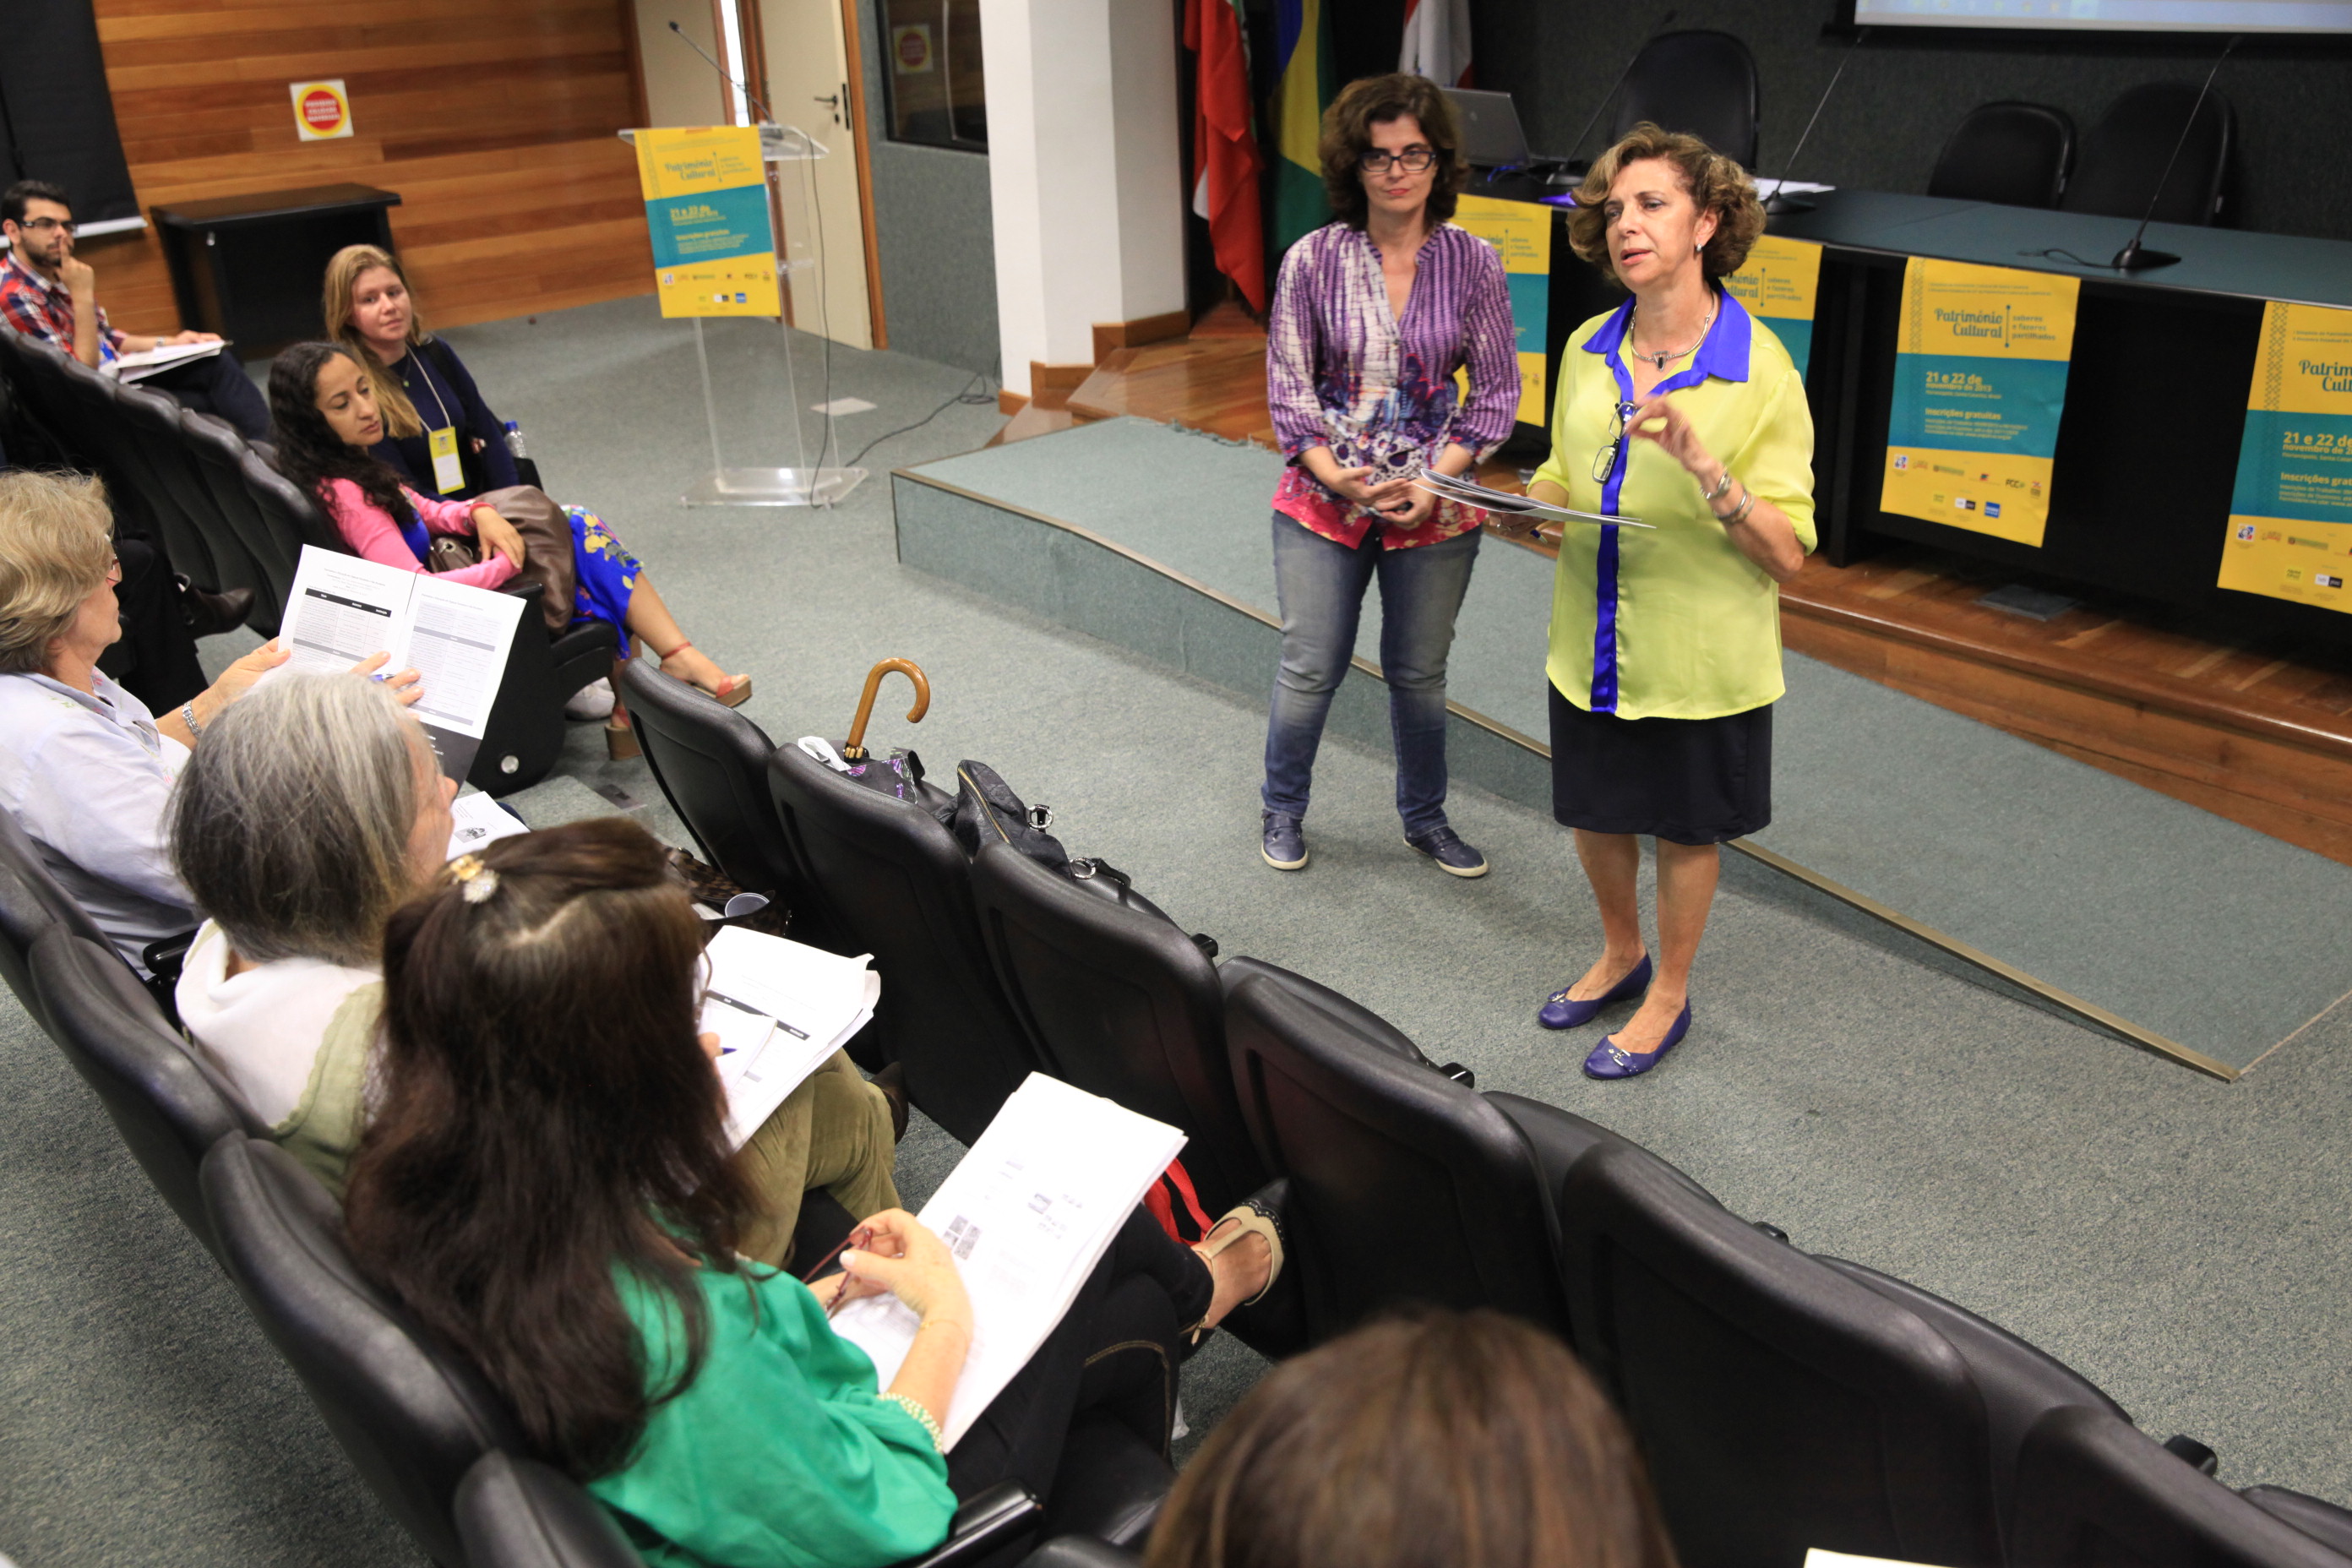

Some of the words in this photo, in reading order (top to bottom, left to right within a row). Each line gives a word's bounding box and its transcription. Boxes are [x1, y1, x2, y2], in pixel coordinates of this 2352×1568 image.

[1952, 323, 2003, 339] Cultural
[1926, 372, 1939, 383] 21
[1941, 374, 1950, 384] e
[1952, 373, 1966, 384] 22
[1968, 373, 1983, 384] de
[2284, 432, 2300, 444] 21
[2304, 435, 2313, 445] e
[2316, 433, 2333, 446] 22
[2283, 444, 2330, 454] novembro
[2332, 446, 2344, 455] de
[2281, 472, 2330, 484] Inscrições
